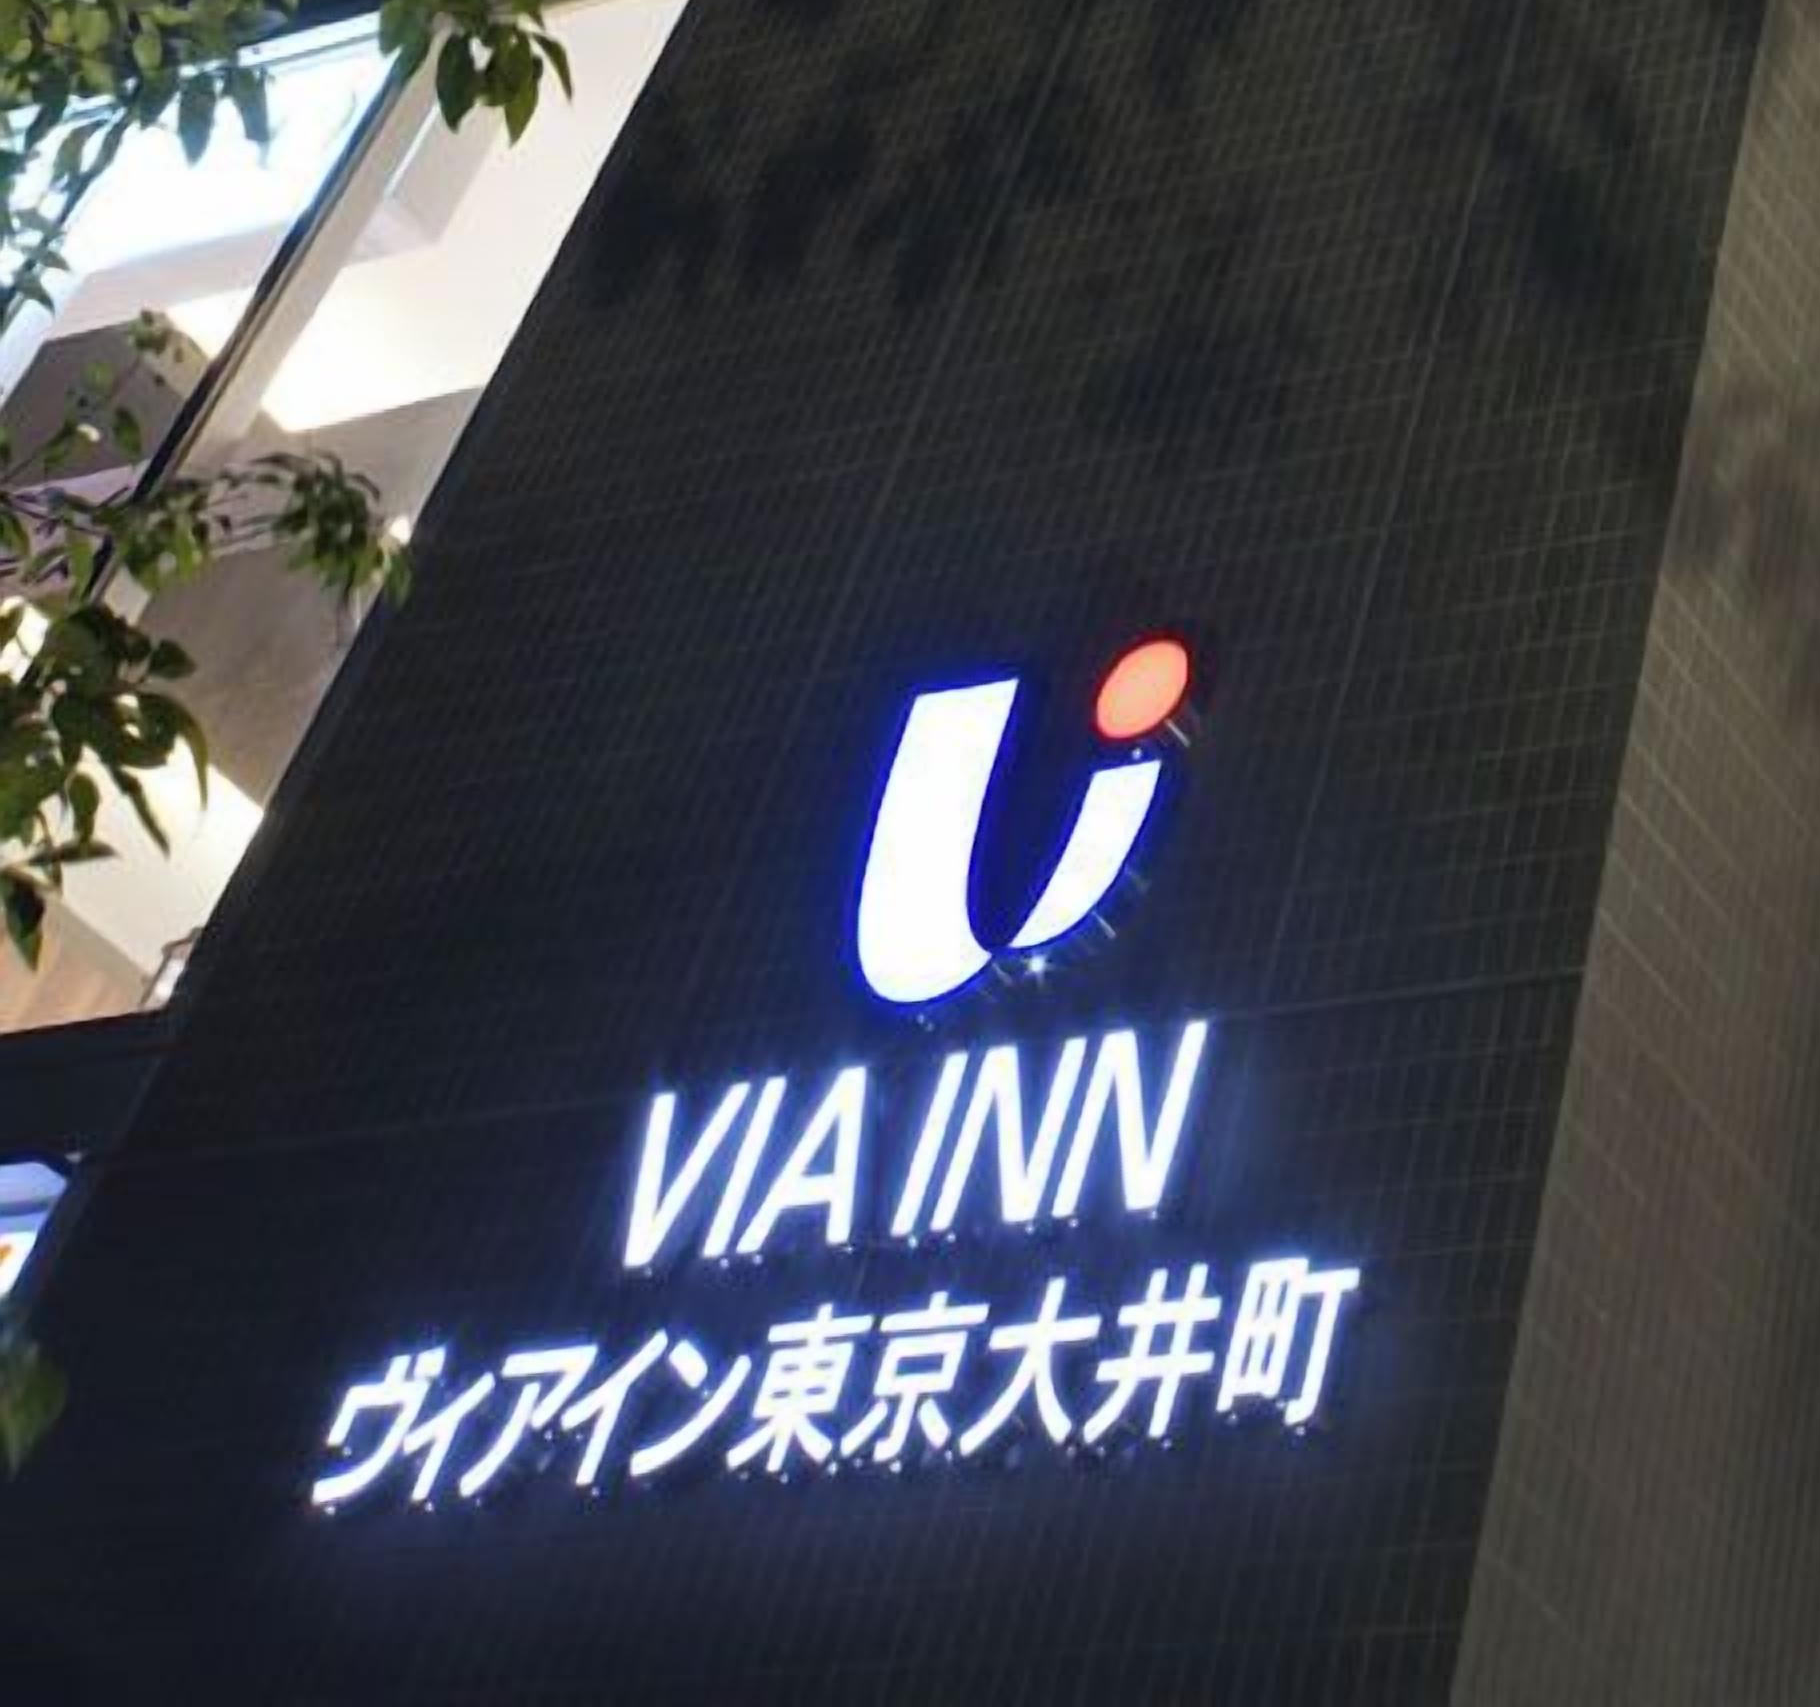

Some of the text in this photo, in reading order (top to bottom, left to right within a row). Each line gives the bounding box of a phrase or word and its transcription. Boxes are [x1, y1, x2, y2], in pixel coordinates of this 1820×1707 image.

[622, 1019, 1209, 1269] VIA INN
[310, 1255, 1361, 1506] ヴィアイン東京大井町
